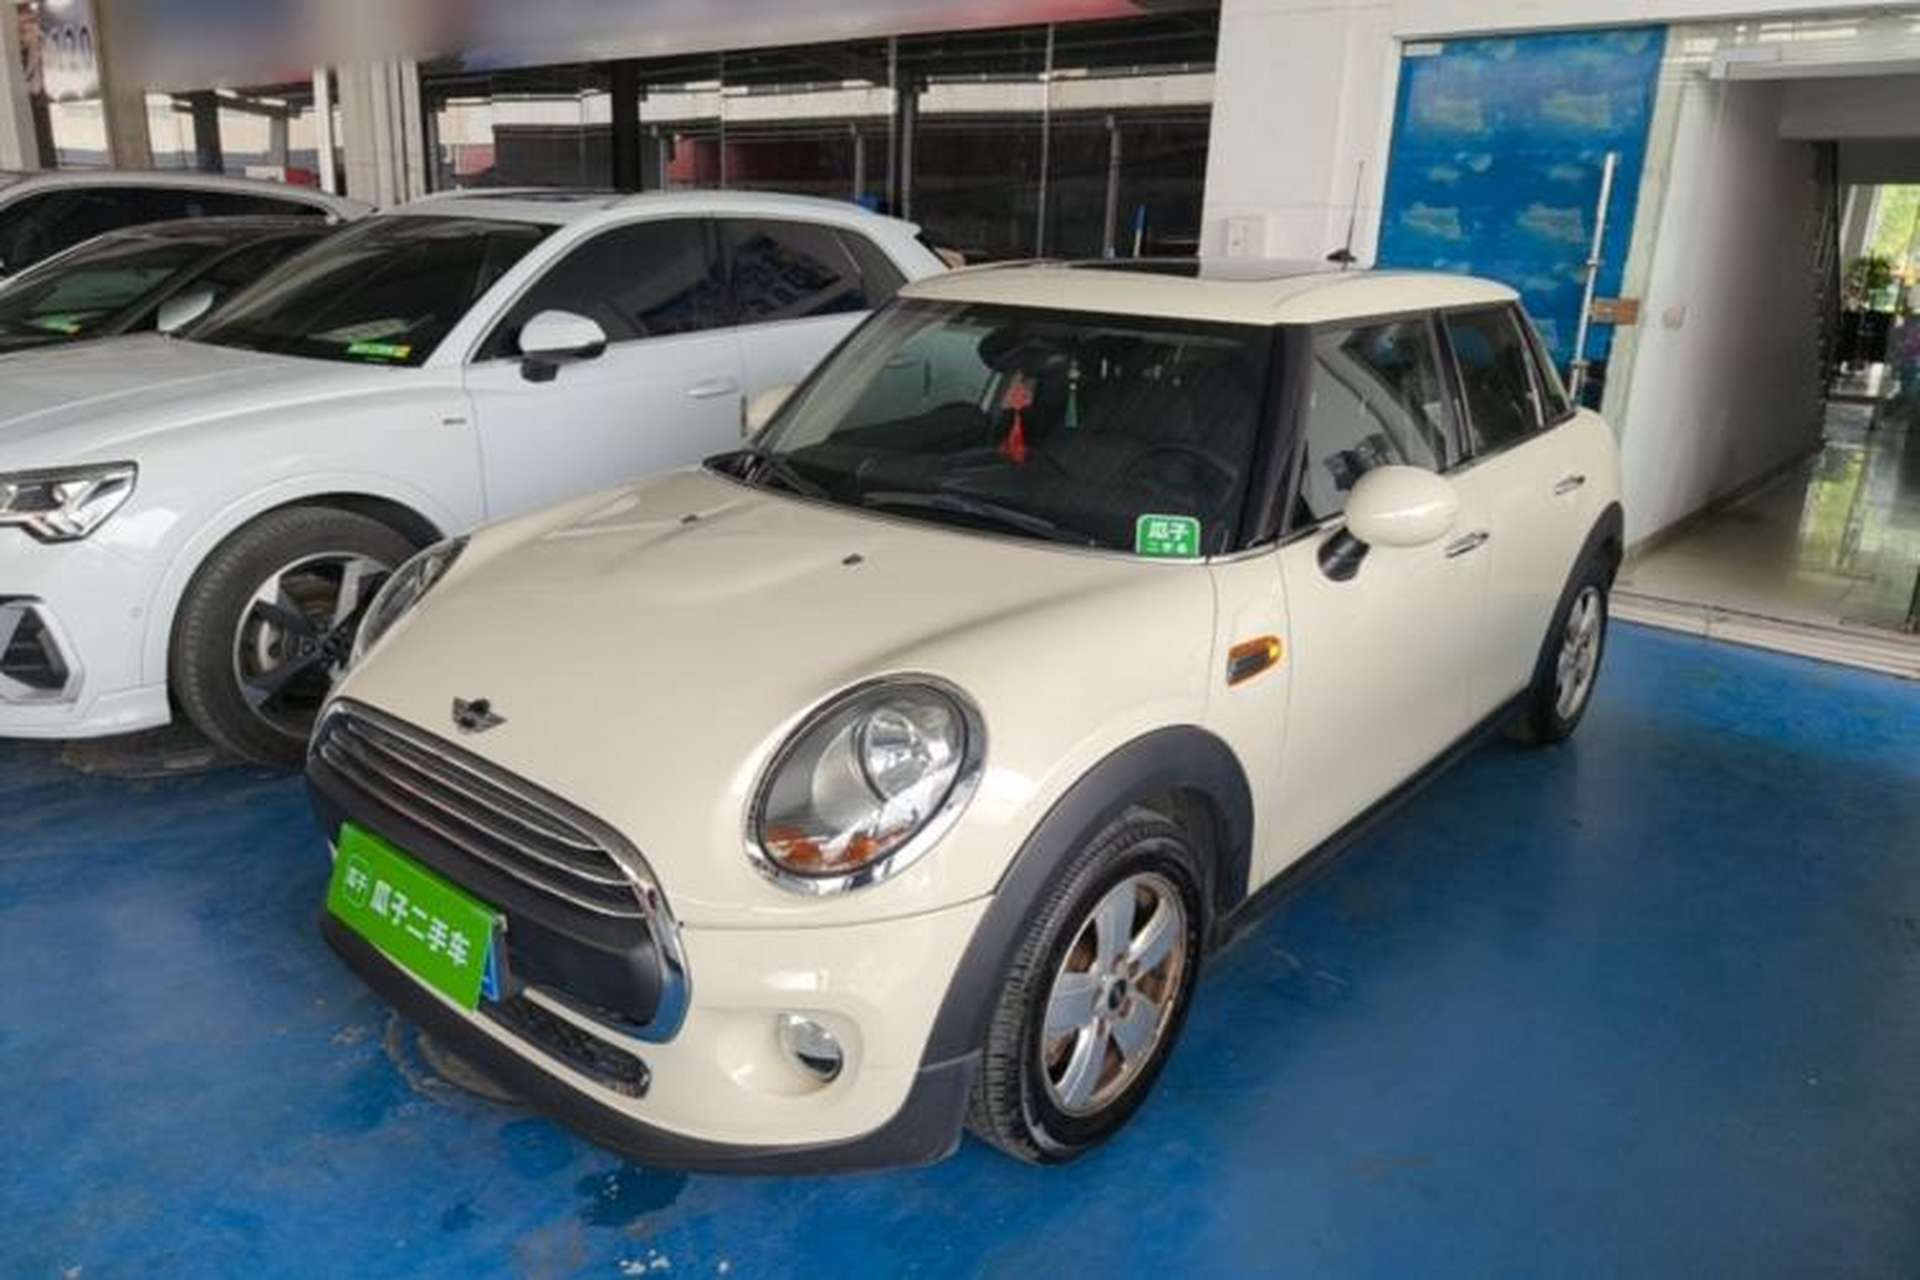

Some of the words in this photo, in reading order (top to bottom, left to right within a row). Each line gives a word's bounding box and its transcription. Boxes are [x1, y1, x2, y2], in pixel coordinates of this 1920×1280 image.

[369, 880, 470, 966] 瓜子二手车
